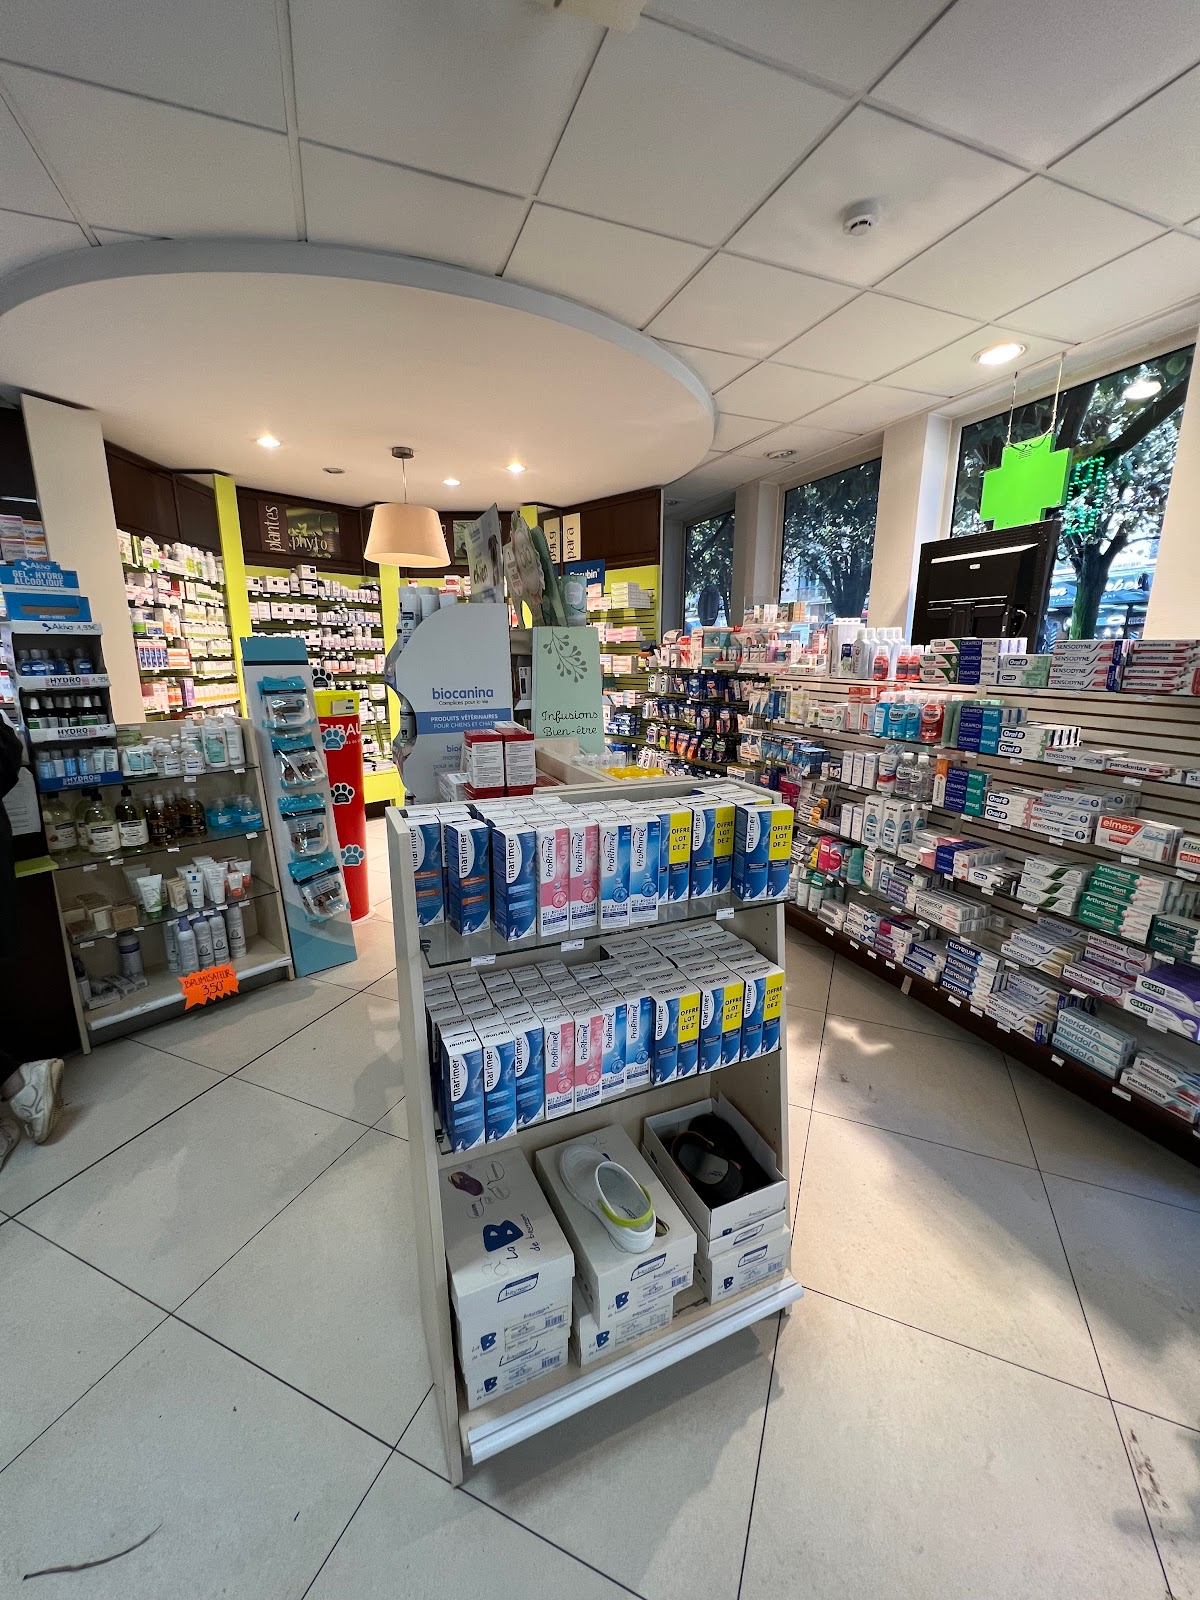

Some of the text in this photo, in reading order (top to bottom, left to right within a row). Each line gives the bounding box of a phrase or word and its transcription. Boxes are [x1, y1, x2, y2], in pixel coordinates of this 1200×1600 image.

[264, 505, 287, 552] plantes
[566, 527, 578, 561] para
[12, 570, 64, 580] GEL HYDRO
[14, 577, 65, 588] ALCOOLIQUE
[50, 676, 82, 684] HYDRO
[432, 687, 494, 700] biocanina
[541, 710, 599, 724] Infusions
[57, 727, 89, 736] HYDRO
[543, 725, 598, 737] Bien-être
[1003, 730, 1025, 738] Oral-B
[1000, 745, 1021, 753] Oral-B
[1046, 752, 1077, 761] SENSODYNE
[1109, 762, 1147, 772] parodontax
[989, 795, 1008, 804] Oral-B
[1044, 792, 1074, 801] SENSODYNE
[987, 810, 1006, 819] Oral-B
[1033, 807, 1064, 817] SENSODYNE
[671, 826, 690, 834] OFFRE
[716, 820, 733, 829] OFFRE
[772, 824, 791, 832] OFFRE
[1032, 822, 1061, 833] SENSODYNE
[1103, 819, 1135, 833] elmex
[1110, 835, 1128, 843] elmex
[460, 833, 468, 874] marimer
[506, 838, 515, 879] marimer
[1098, 866, 1131, 880] Arthrodont
[1093, 880, 1127, 894] Arthrodont
[1086, 895, 1119, 910] Arthrodont
[1083, 910, 1115, 925] Arthrodont
[1040, 918, 1073, 933] SENSODYNE
[1157, 921, 1190, 935] Arthrodont
[1013, 934, 1045, 951] SENSODYNE
[1089, 935, 1124, 951] parodontax
[1154, 936, 1186, 951] Arthrodont
[949, 942, 975, 958] ELGYDIUM
[1003, 946, 1035, 963] SENSODYNE
[947, 957, 972, 973] ELGYDIUM
[1086, 949, 1121, 967] parodontax
[184, 968, 234, 989] BRUMISATEUR
[945, 968, 969, 984] ELGYDIUM
[1010, 974, 1040, 992] SENSODYNE
[1064, 968, 1100, 986] parodontax
[766, 986, 782, 995] OFFRE
[942, 981, 967, 997] ELGYDIUM
[1009, 984, 1038, 1001] SENSODYNE
[724, 996, 742, 1006] OFFRE
[769, 994, 779, 1002] LOT
[680, 1007, 699, 1016] OFFRE
[727, 1004, 738, 1013] LOT
[989, 1000, 1018, 1018] SENSODYNE
[683, 1015, 695, 1023] LOT
[1059, 1013, 1094, 1036] meridol
[1058, 1027, 1091, 1049] meridol
[515, 1037, 523, 1073] marimer
[1053, 1037, 1088, 1060] meridol
[485, 1050, 494, 1087] marimer
[1139, 1060, 1177, 1084] parodontax
[1126, 1076, 1166, 1099] parodontax
